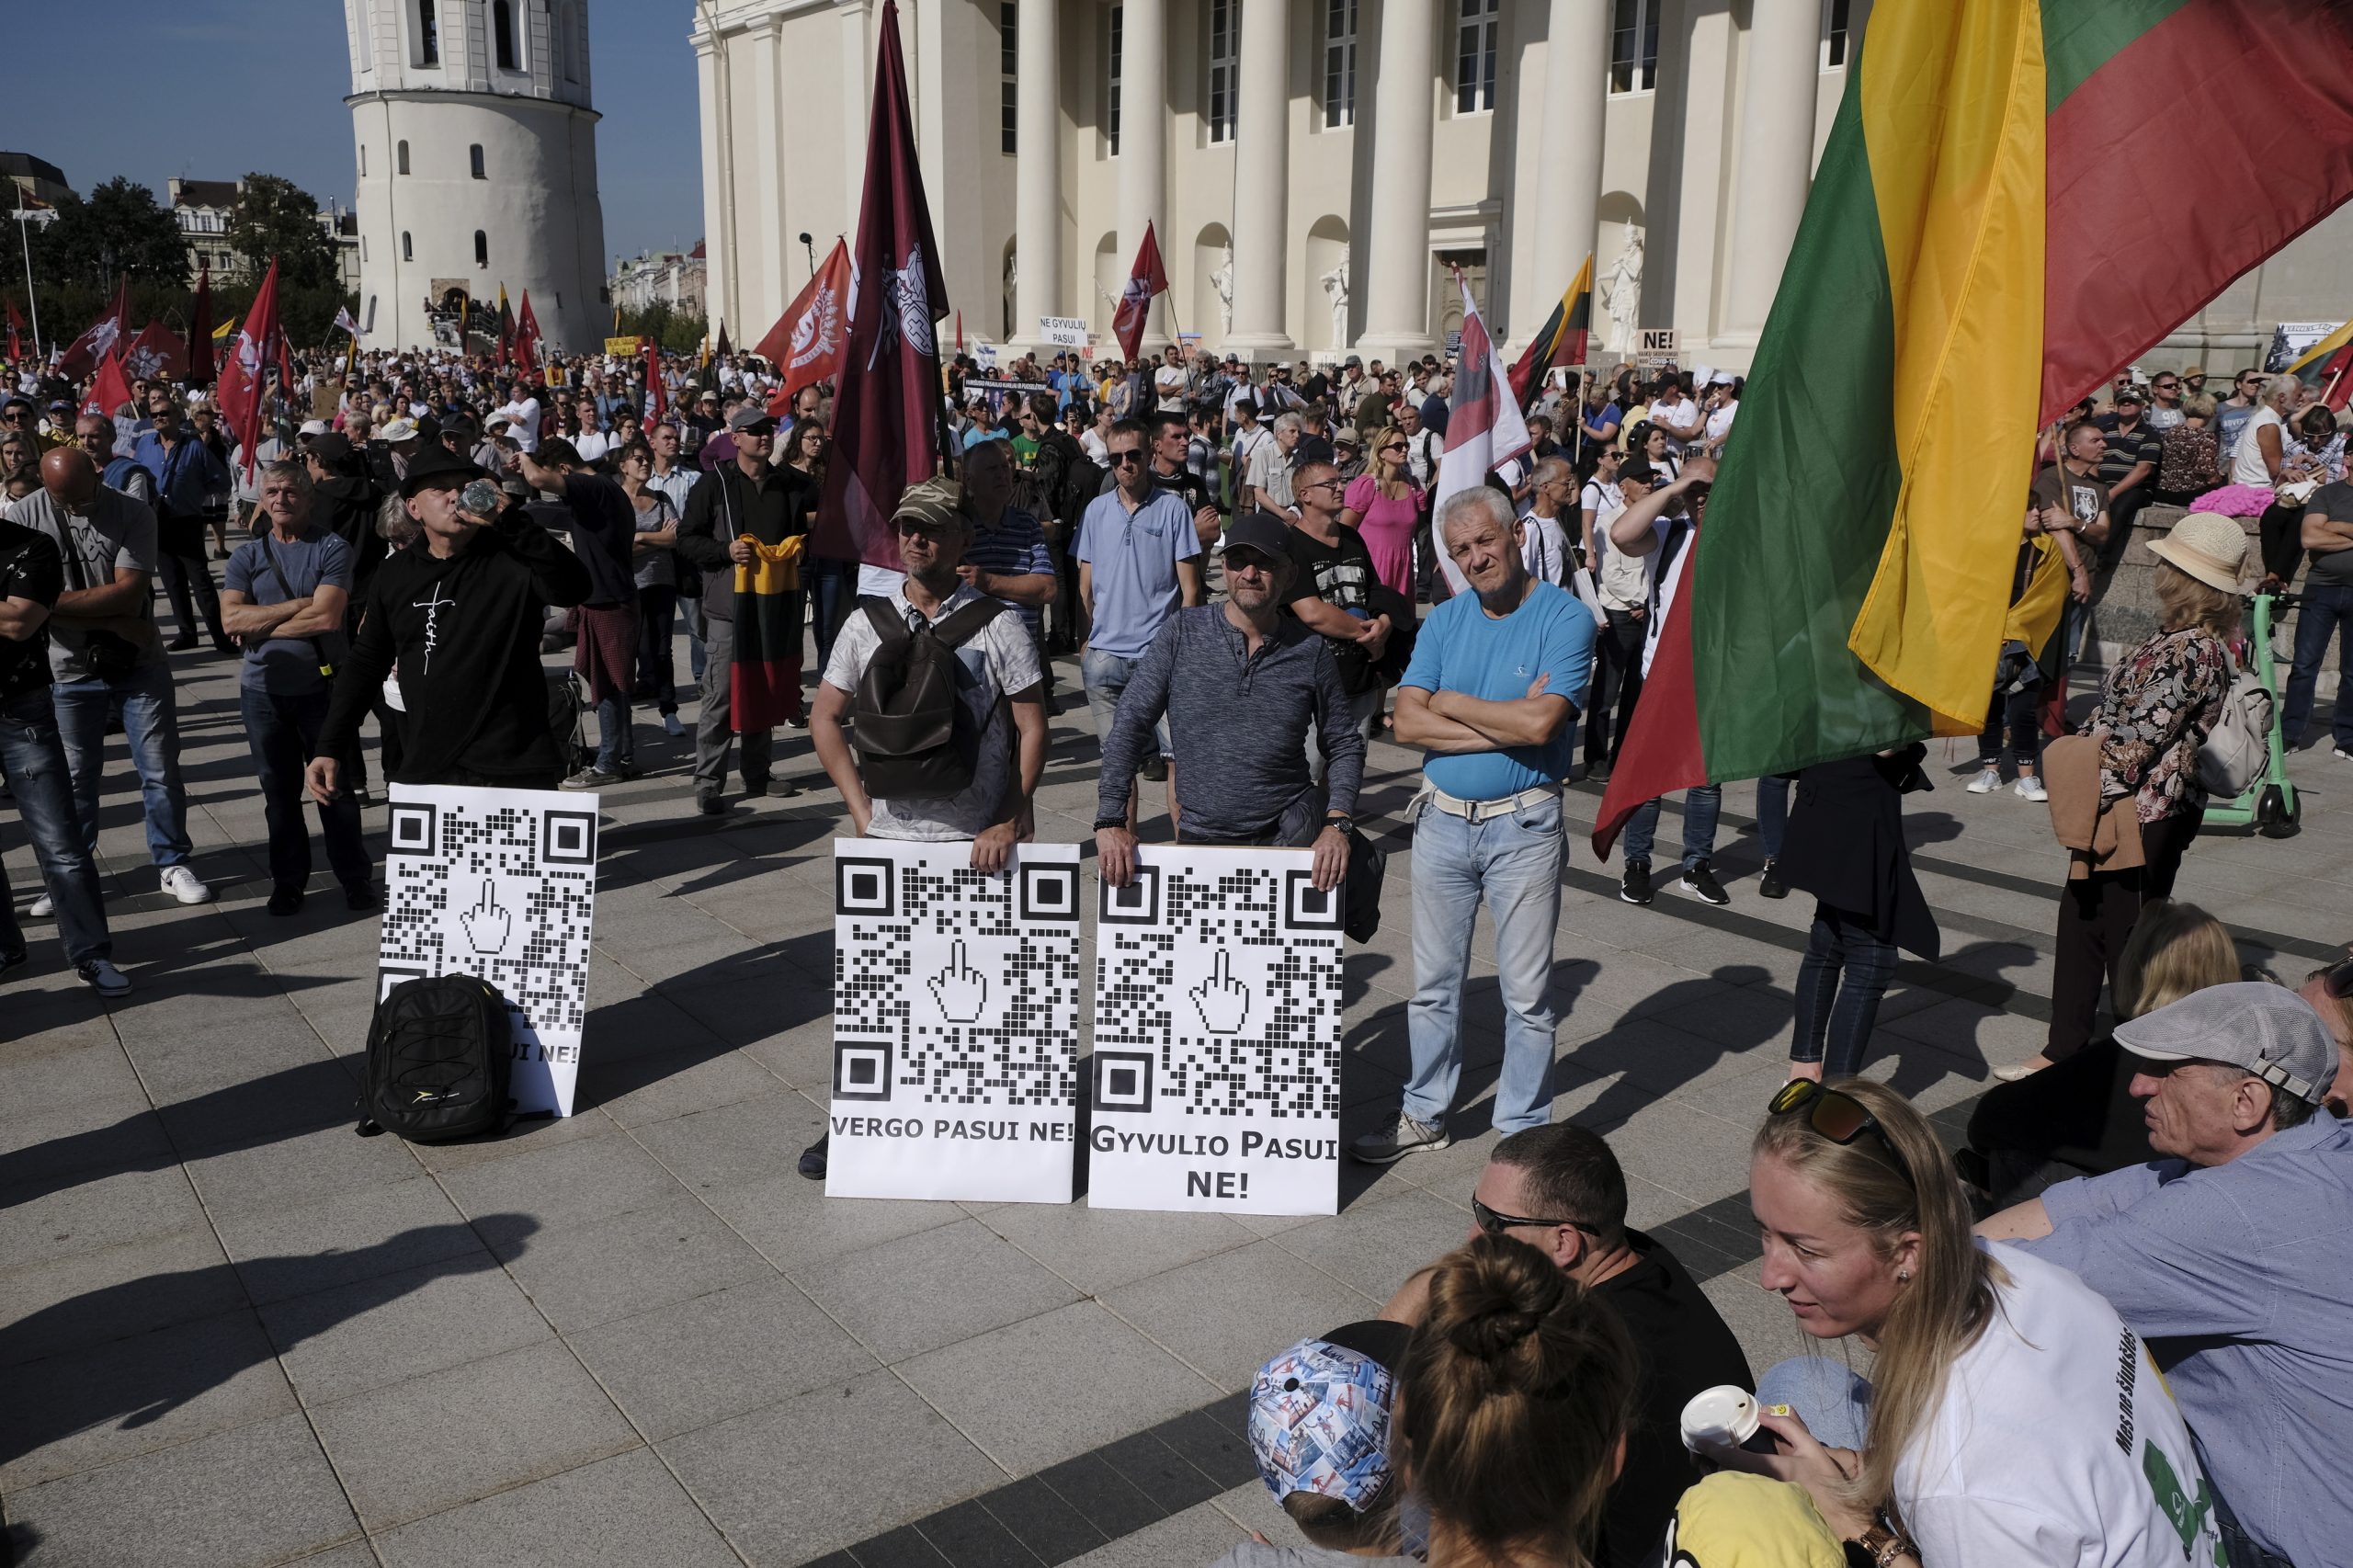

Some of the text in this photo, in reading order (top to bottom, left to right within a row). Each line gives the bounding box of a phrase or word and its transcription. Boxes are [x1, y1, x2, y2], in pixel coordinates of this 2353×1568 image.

[1040, 318, 1051, 327] NE
[1053, 334, 1075, 344] PASUI
[1644, 332, 1673, 348] NE!
[2162, 411, 2178, 426] 98
[539, 1045, 577, 1063] NE!
[831, 1116, 1074, 1142] VERGO PASUI NE!
[1187, 1171, 1249, 1199] NE!
[2120, 1392, 2133, 1421] ne
[2115, 1414, 2134, 1457] Mes
